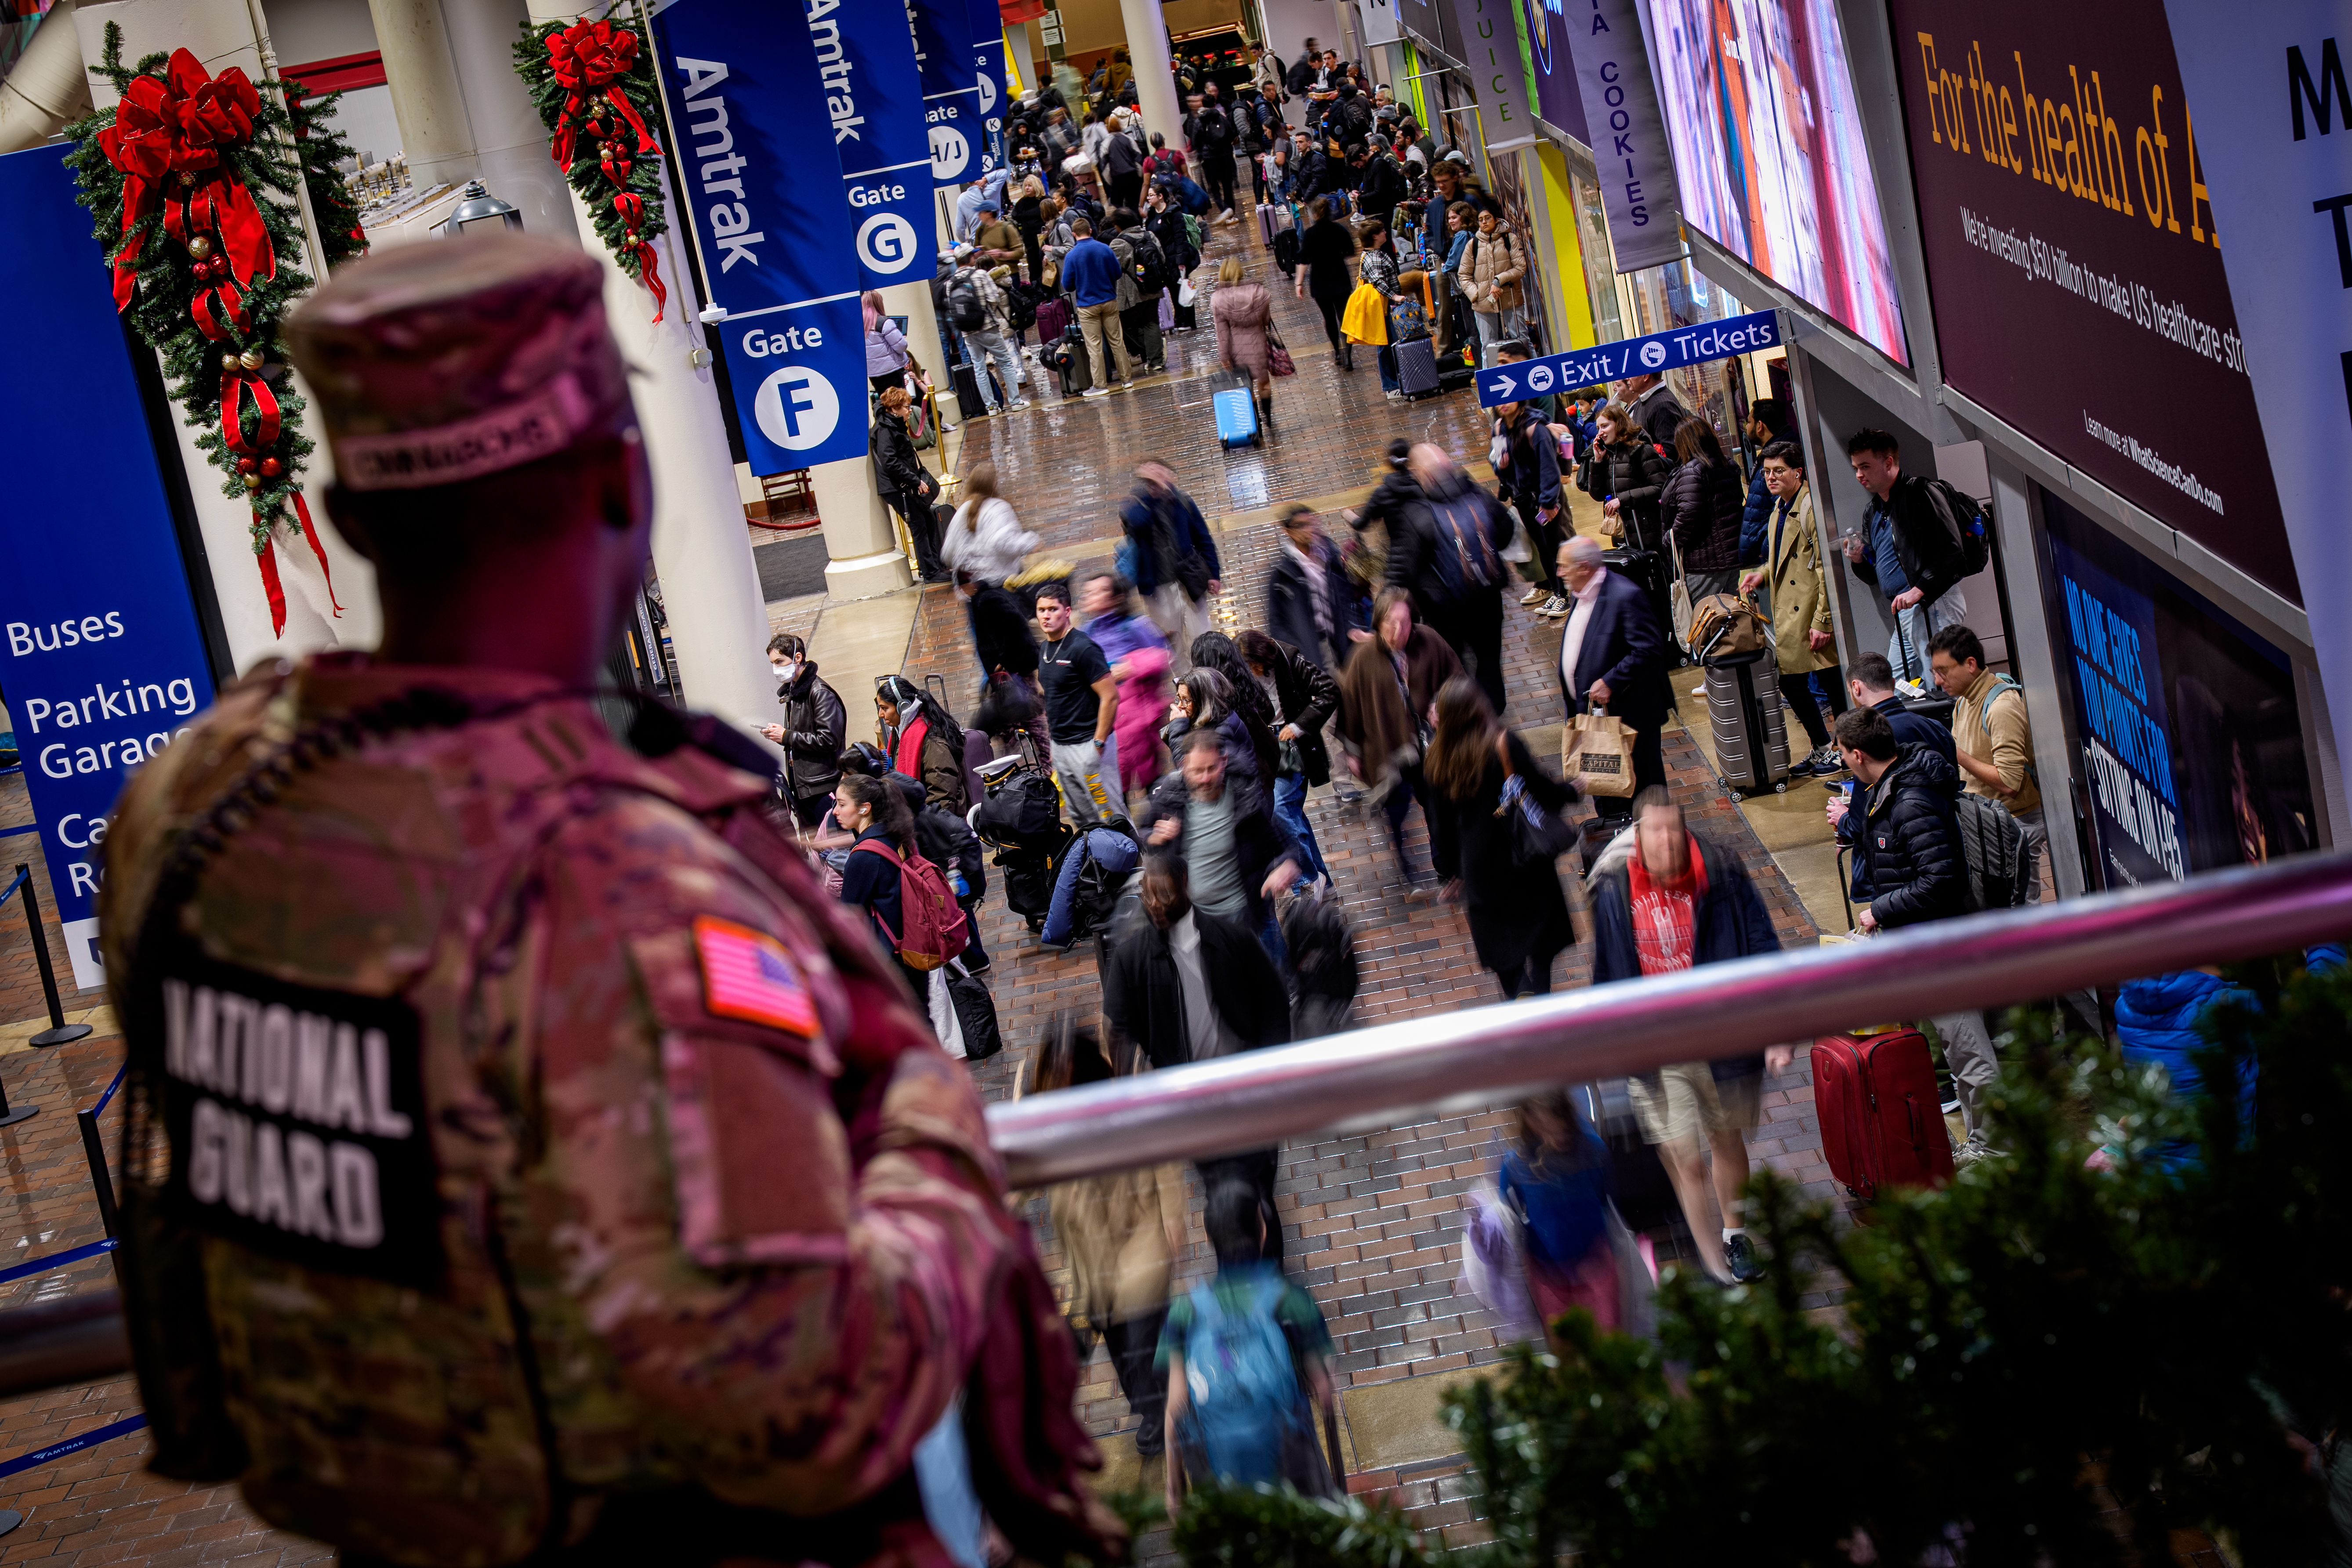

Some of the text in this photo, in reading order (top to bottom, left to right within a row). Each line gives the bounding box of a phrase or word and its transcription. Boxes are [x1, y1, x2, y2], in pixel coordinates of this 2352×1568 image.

[807, 0, 864, 145] Amtrak
[1476, 0, 1513, 122] JUICE
[925, 106, 958, 123] ate
[980, 84, 992, 99] L
[989, 119, 998, 130] K
[993, 133, 1001, 156] BOARDING
[1600, 61, 1649, 227] COOKIES
[1917, 31, 1971, 154] For
[1968, 40, 2022, 175] the
[2014, 51, 2134, 217] health
[2136, 84, 2180, 234] of
[676, 56, 765, 274] Amtrak
[848, 184, 906, 208] Gate
[867, 223, 901, 263] G
[1960, 206, 1988, 251] We're
[1986, 216, 2032, 281] investing
[2029, 232, 2052, 281] $50
[2051, 245, 2086, 297] billion
[2084, 263, 2098, 304] to
[2098, 273, 2131, 320] make
[2130, 281, 2152, 330] US
[2150, 290, 2222, 363] healthcare
[743, 326, 823, 358] Gate
[1561, 353, 1614, 386] Exit
[1674, 323, 1772, 361] Tickets
[777, 378, 814, 438] F
[2084, 409, 2224, 517] Learn more at WhatScienceCanDo.com
[6, 611, 124, 657] Buses
[2064, 575, 2148, 707] NO ONE GIVES
[25, 677, 196, 734] Parking
[2076, 655, 2177, 808] YOU POINTS FOR
[40, 728, 192, 779] Garag
[1581, 760, 1619, 768] CAPITAL
[1084, 773, 1109, 804] NAVY
[2090, 737, 2185, 885] SITTING ON I-95
[58, 813, 117, 848] Ca
[2109, 848, 2120, 871] Earn
[2118, 863, 2131, 884] points
[163, 976, 413, 1140] NATIONAL
[188, 1097, 384, 1248] GUARD
[47, 1441, 84, 1456] AMTRAK
